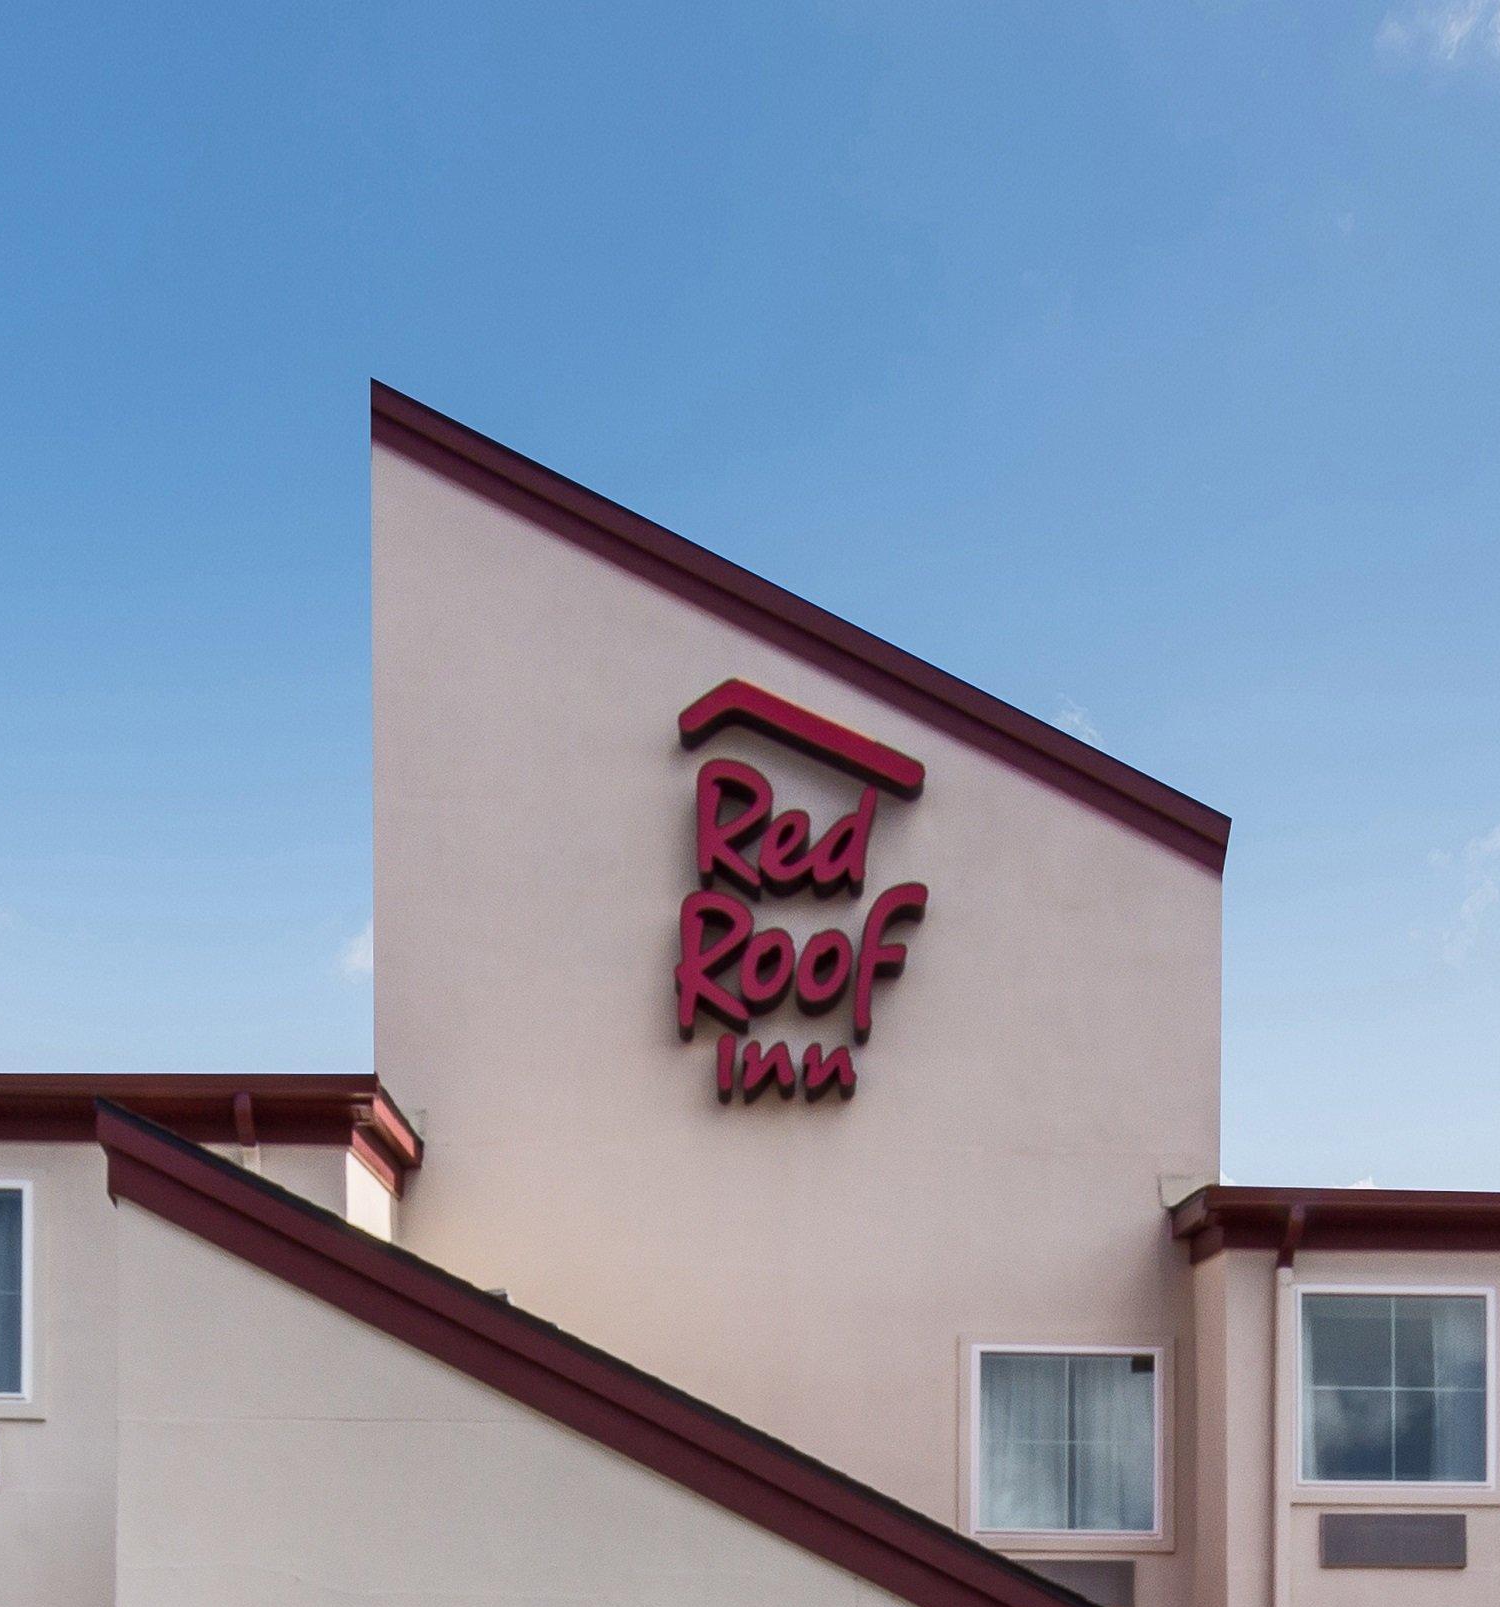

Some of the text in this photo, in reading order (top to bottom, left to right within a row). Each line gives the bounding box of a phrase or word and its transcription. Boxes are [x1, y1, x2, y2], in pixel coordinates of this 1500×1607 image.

[697, 758, 877, 899] Red
[675, 882, 928, 1042] Roof
[717, 1033, 856, 1103] Inn
